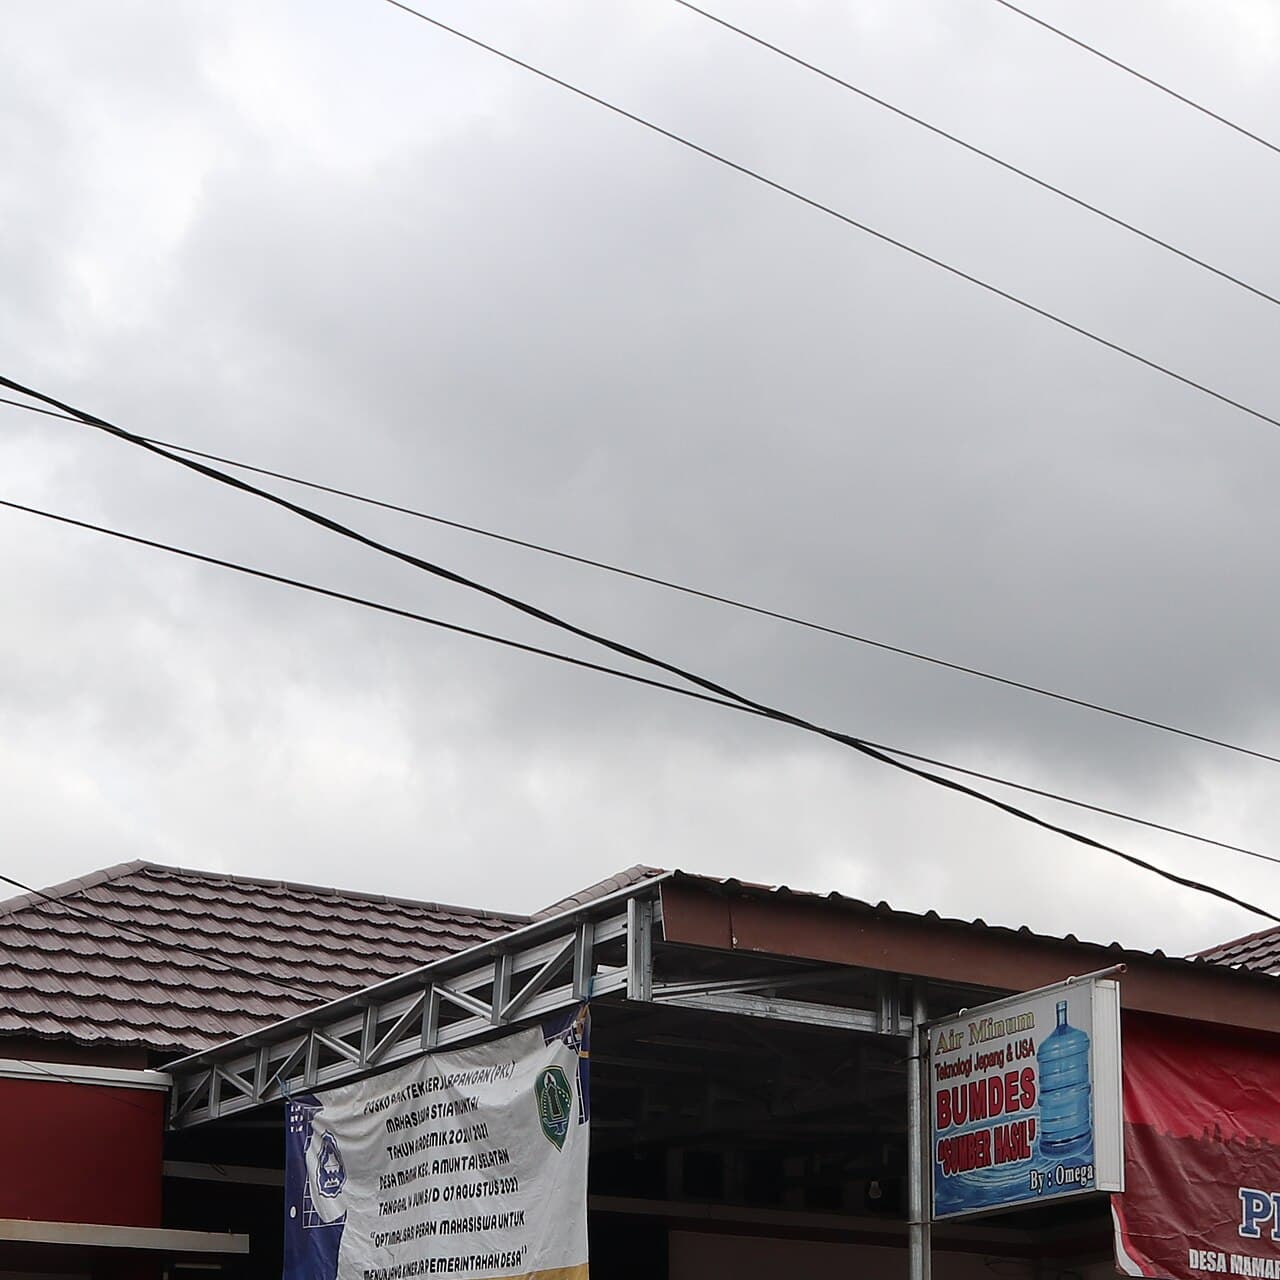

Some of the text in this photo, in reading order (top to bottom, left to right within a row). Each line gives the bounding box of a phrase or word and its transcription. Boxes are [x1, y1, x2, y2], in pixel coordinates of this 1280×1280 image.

[935, 1012, 1035, 1055] Air Minum
[490, 1060, 515, 1084] (PKL)
[935, 1038, 1036, 1081] Teknologi Jepang & USA
[936, 1067, 1036, 1130] BUMDES
[385, 1107, 430, 1134] MAHASIWA
[431, 1102, 454, 1120] STIA
[386, 1140, 415, 1161] TAHUN
[379, 1172, 397, 1190] DESA
[432, 1154, 478, 1174] AMUNTAI
[478, 1148, 510, 1169] SELATAN
[1030, 1170, 1044, 1193] By
[1056, 1165, 1094, 1185] Omega
[443, 1185, 455, 1202] 07
[456, 1181, 499, 1201] AGUSTUS
[500, 1176, 519, 1195] 2021
[439, 1213, 497, 1235] MAHASISWA
[497, 1211, 525, 1229] UNTUK
[425, 1254, 499, 1275] PEMERINTAHAN
[1189, 1249, 1227, 1273] DESA
